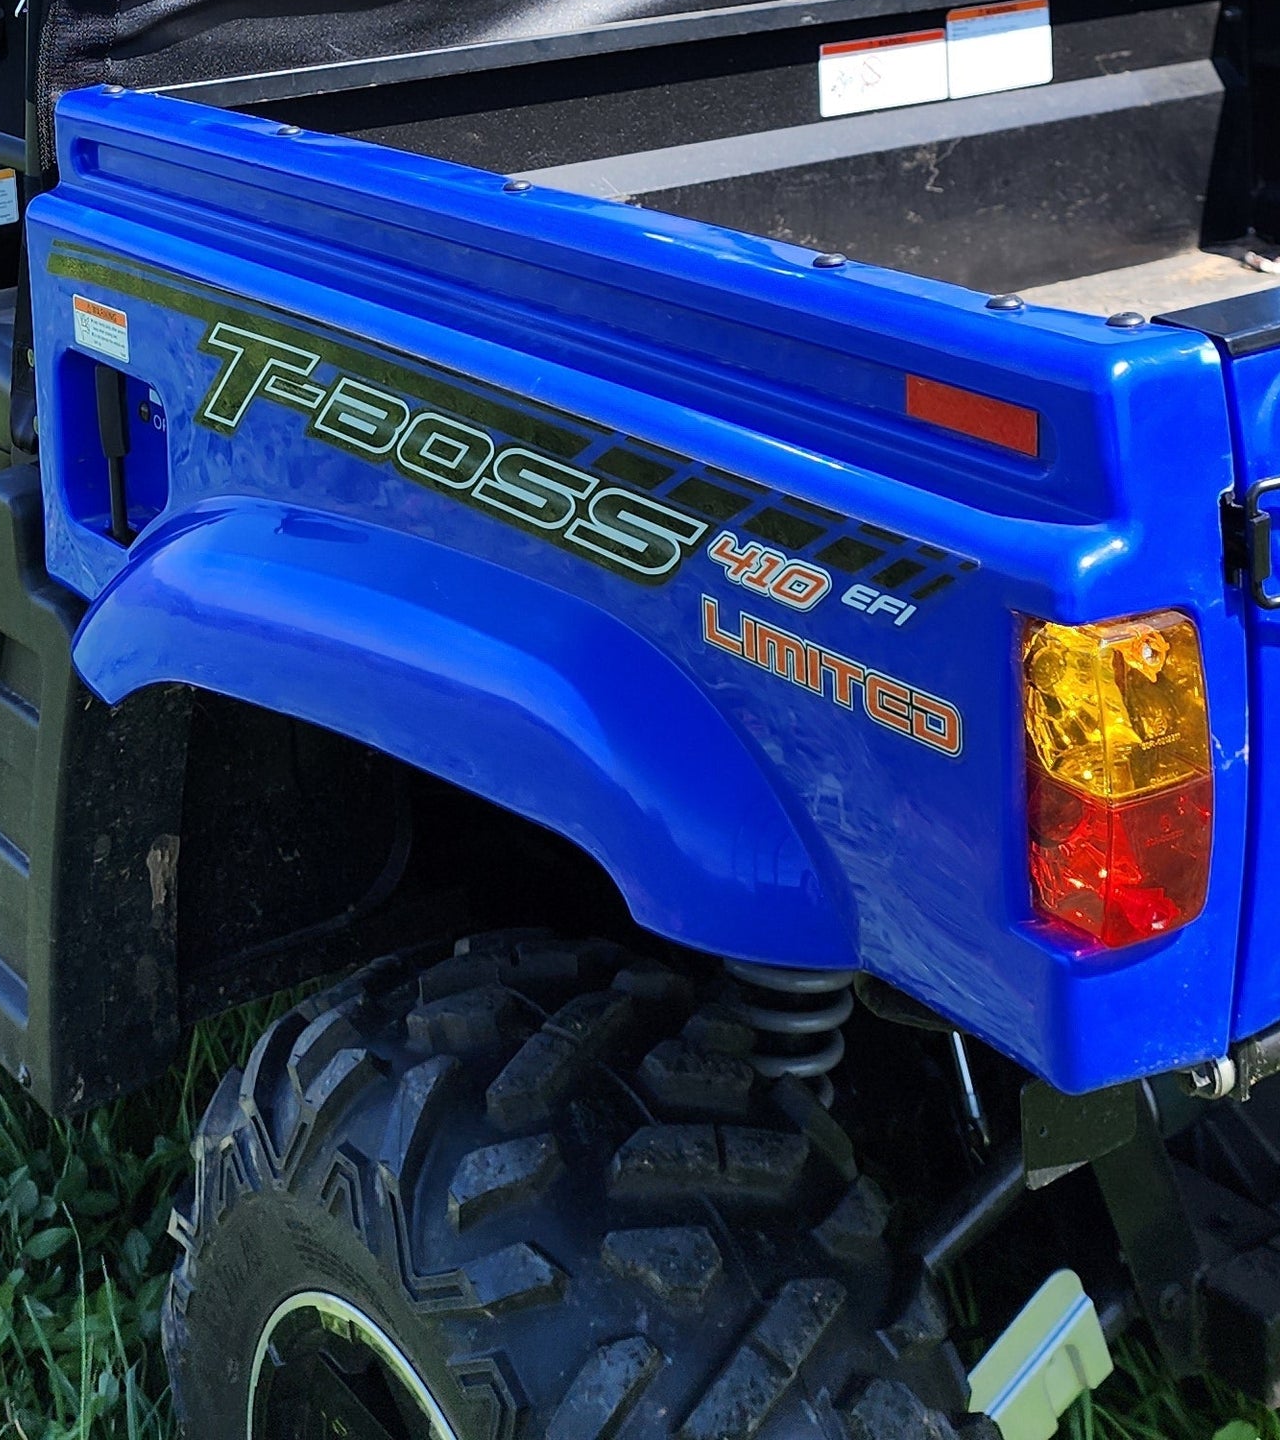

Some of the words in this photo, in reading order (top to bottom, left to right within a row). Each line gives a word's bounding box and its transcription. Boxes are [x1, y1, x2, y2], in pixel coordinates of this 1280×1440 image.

[204, 321, 709, 576] T-BOSS
[707, 530, 832, 613] 410
[841, 583, 917, 627] EFI
[701, 592, 963, 758] LIMITED
